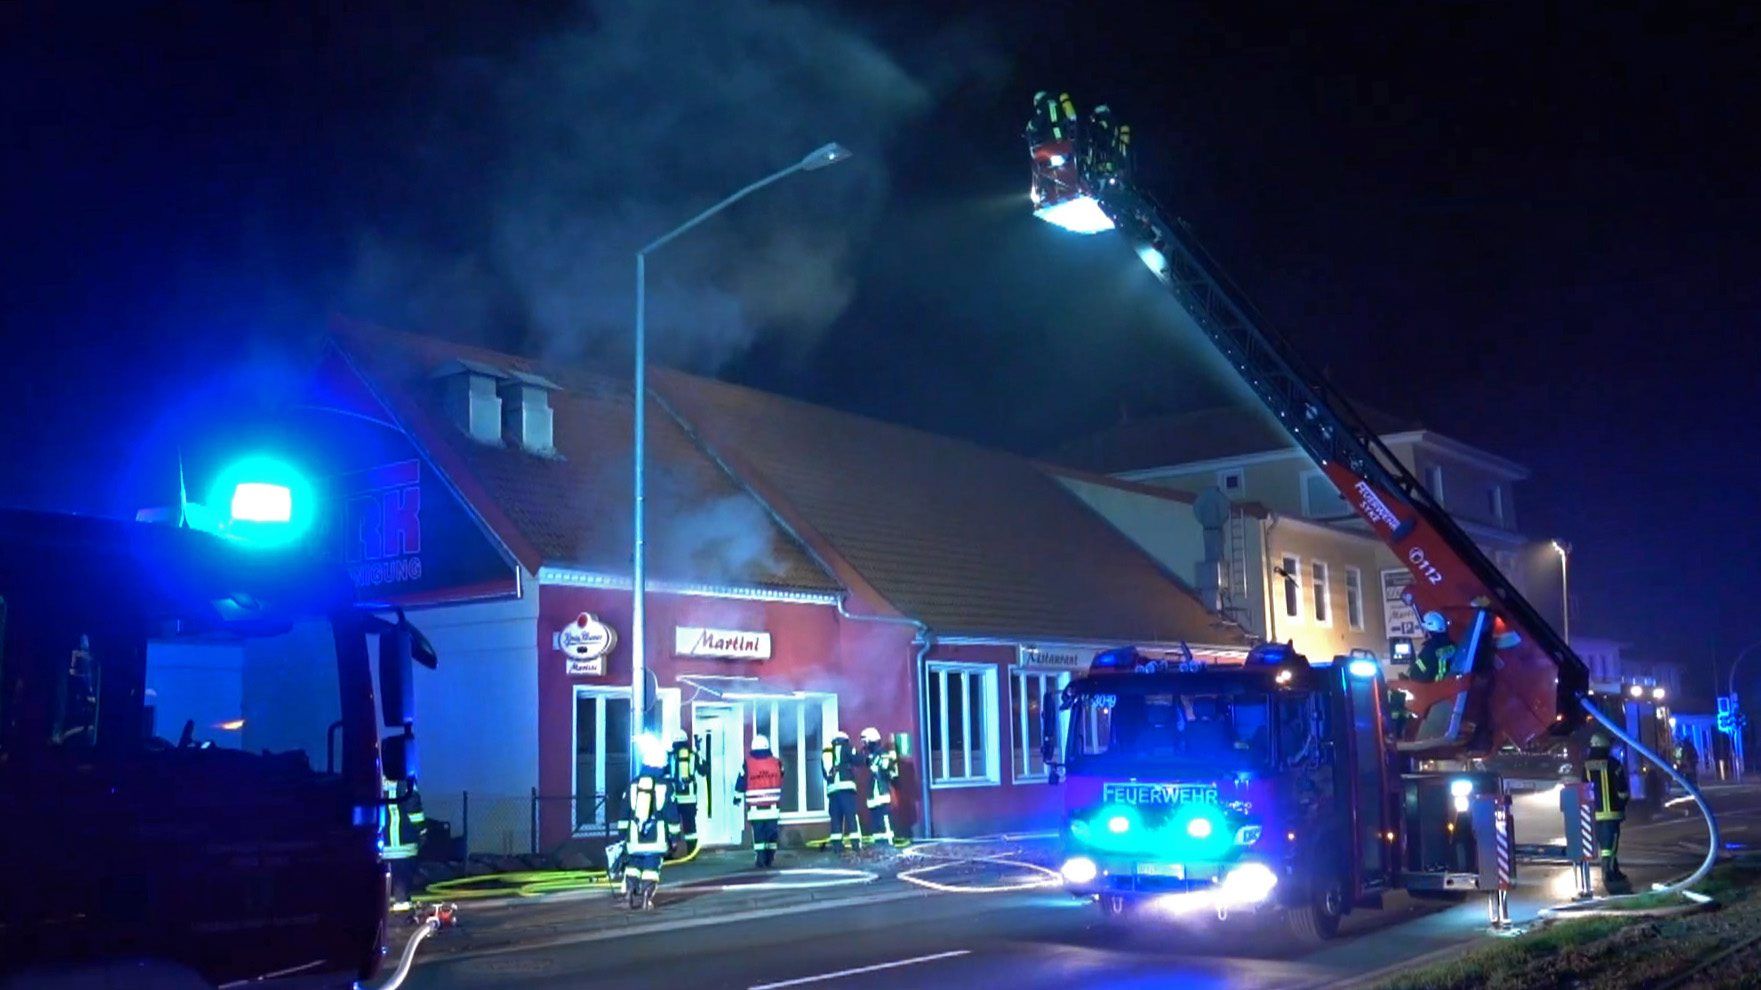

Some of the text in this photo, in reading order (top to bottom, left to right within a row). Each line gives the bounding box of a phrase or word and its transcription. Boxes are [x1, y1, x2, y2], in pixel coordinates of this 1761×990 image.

[1419, 560, 1442, 585] 112
[690, 627, 759, 655] Martini
[1103, 783, 1218, 804] FEUERWEHR
